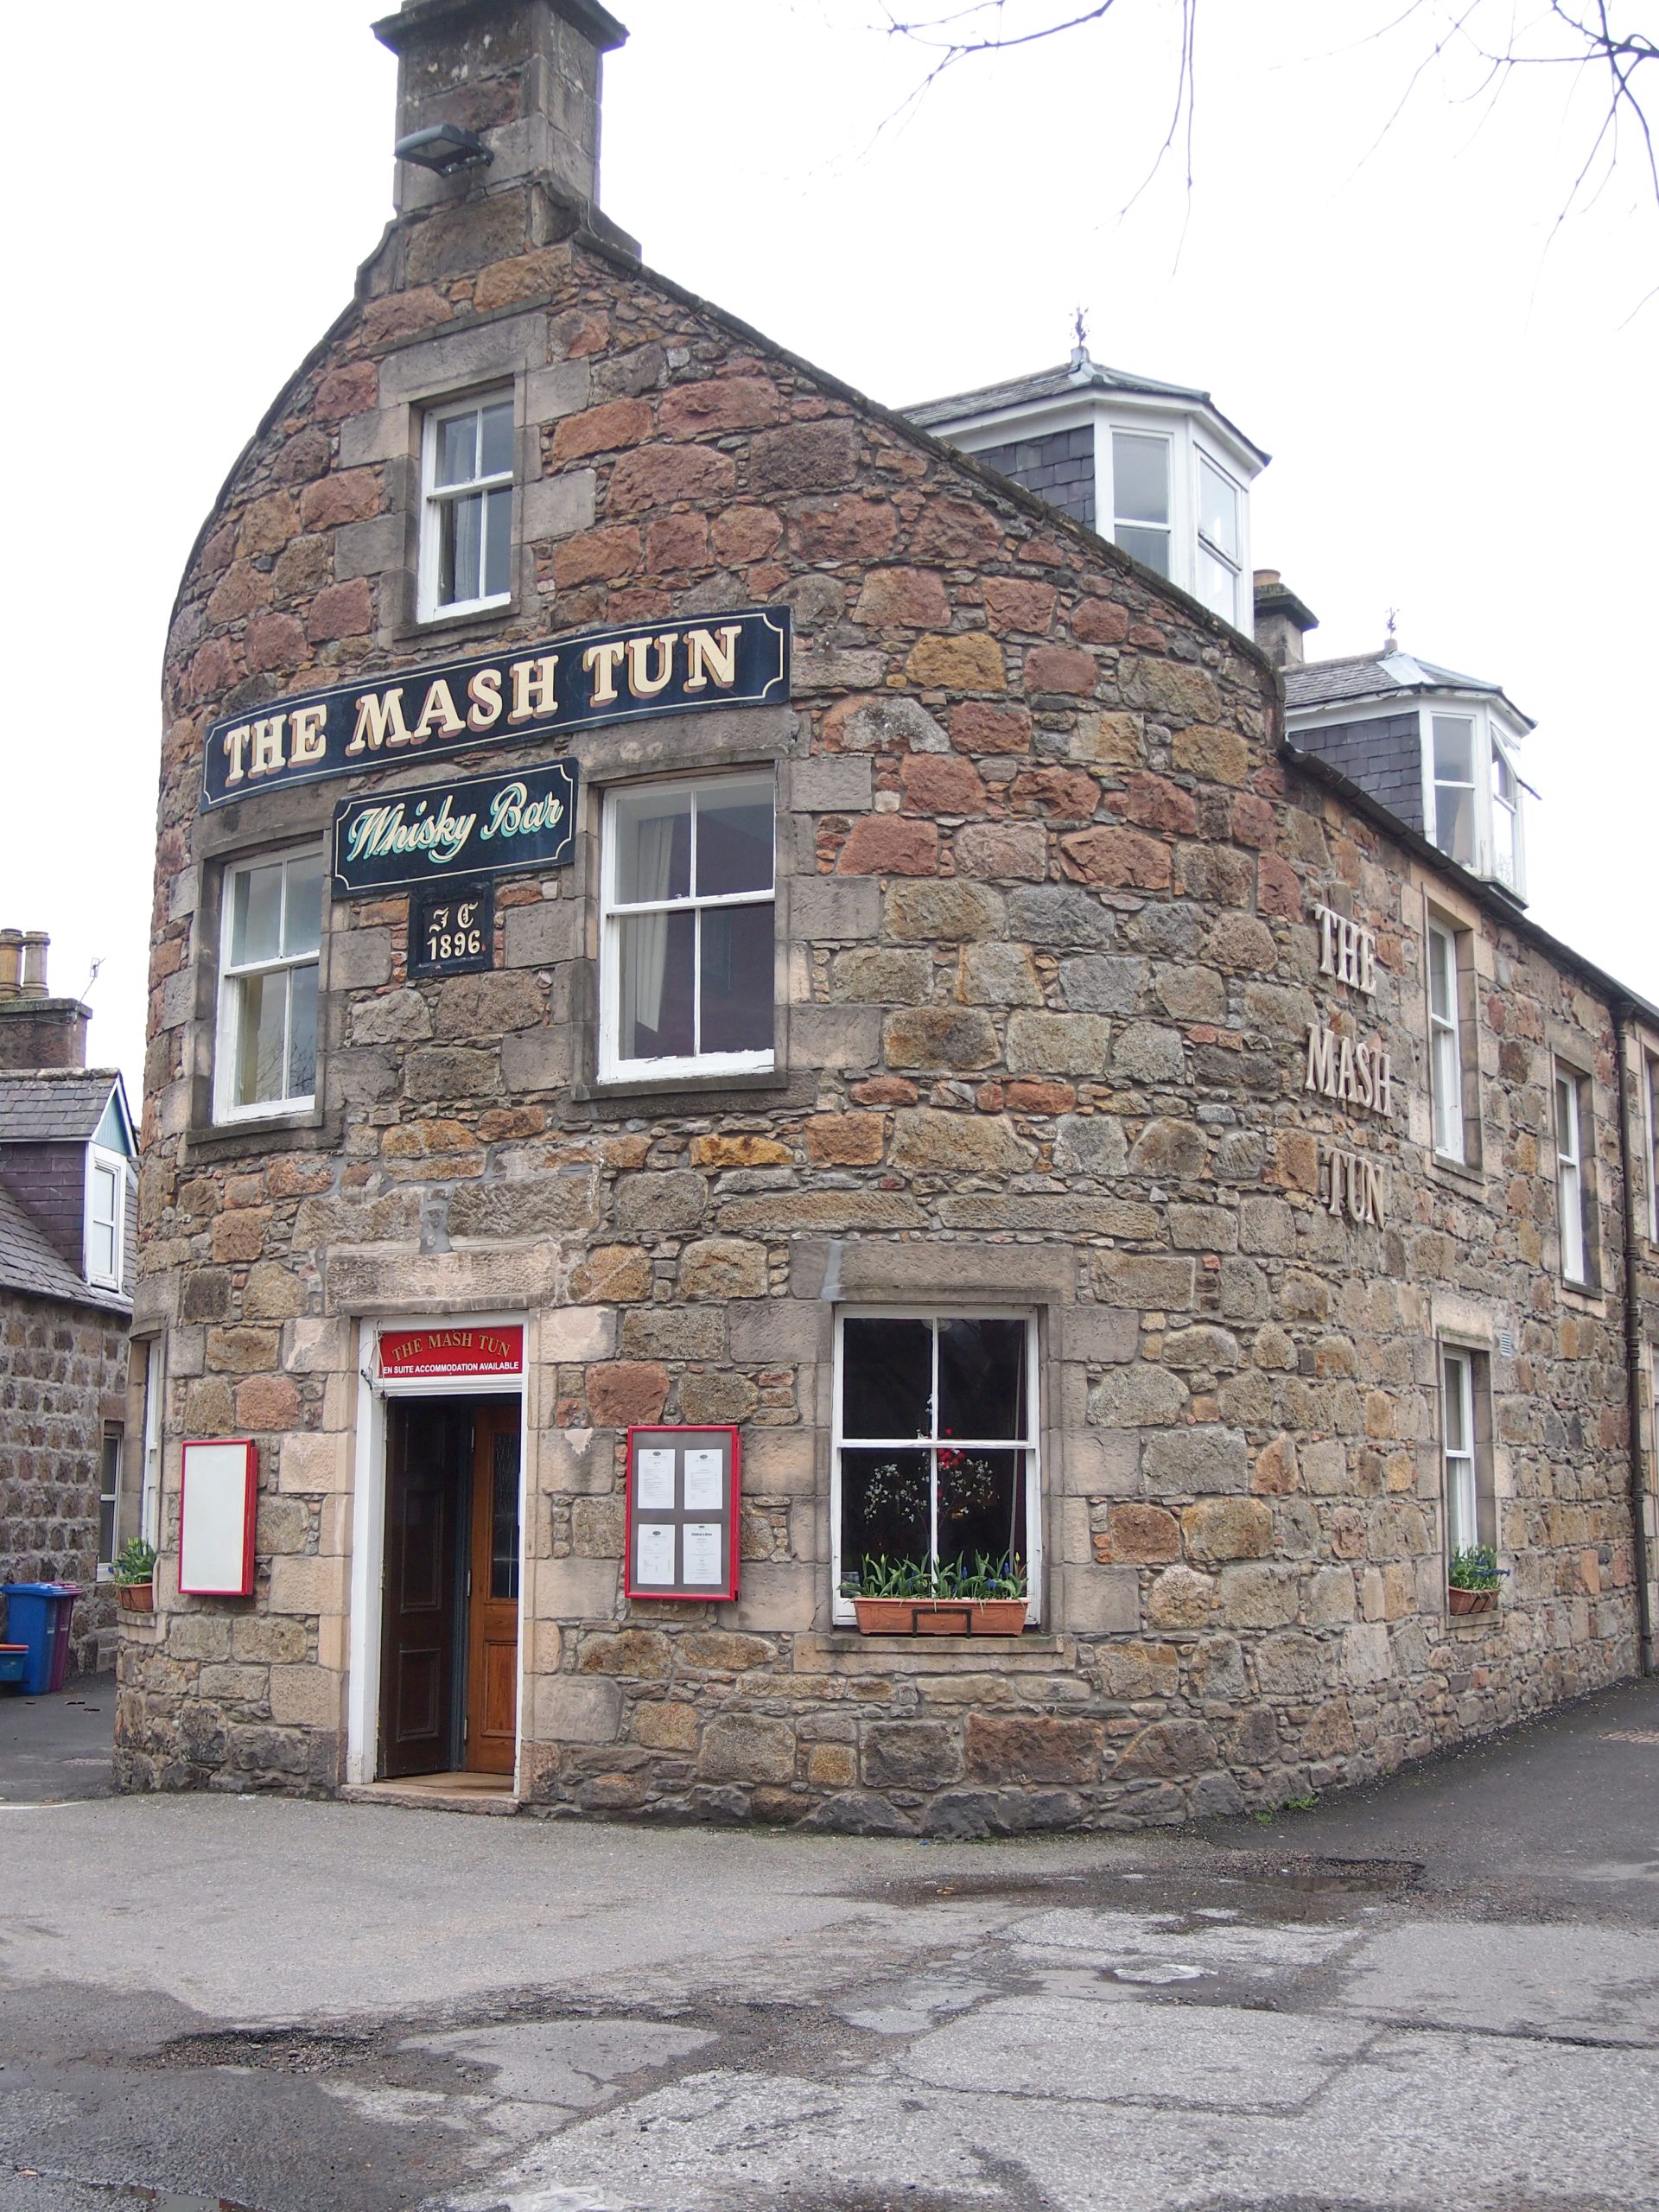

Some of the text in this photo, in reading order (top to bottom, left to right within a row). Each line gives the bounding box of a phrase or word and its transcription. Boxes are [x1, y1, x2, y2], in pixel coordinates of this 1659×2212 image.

[224, 625, 742, 788] THE MASH TUN
[346, 782, 564, 863] Whisky Bar
[426, 929, 480, 961] 1896
[1314, 903, 1377, 997] THE
[1305, 1022, 1393, 1119] MASH
[1324, 1145, 1384, 1231] TUN
[383, 1361, 519, 1375] EN SUITE ACCOMMODATION AVAILABLE
[391, 1332, 512, 1363] THE MASH TUN
